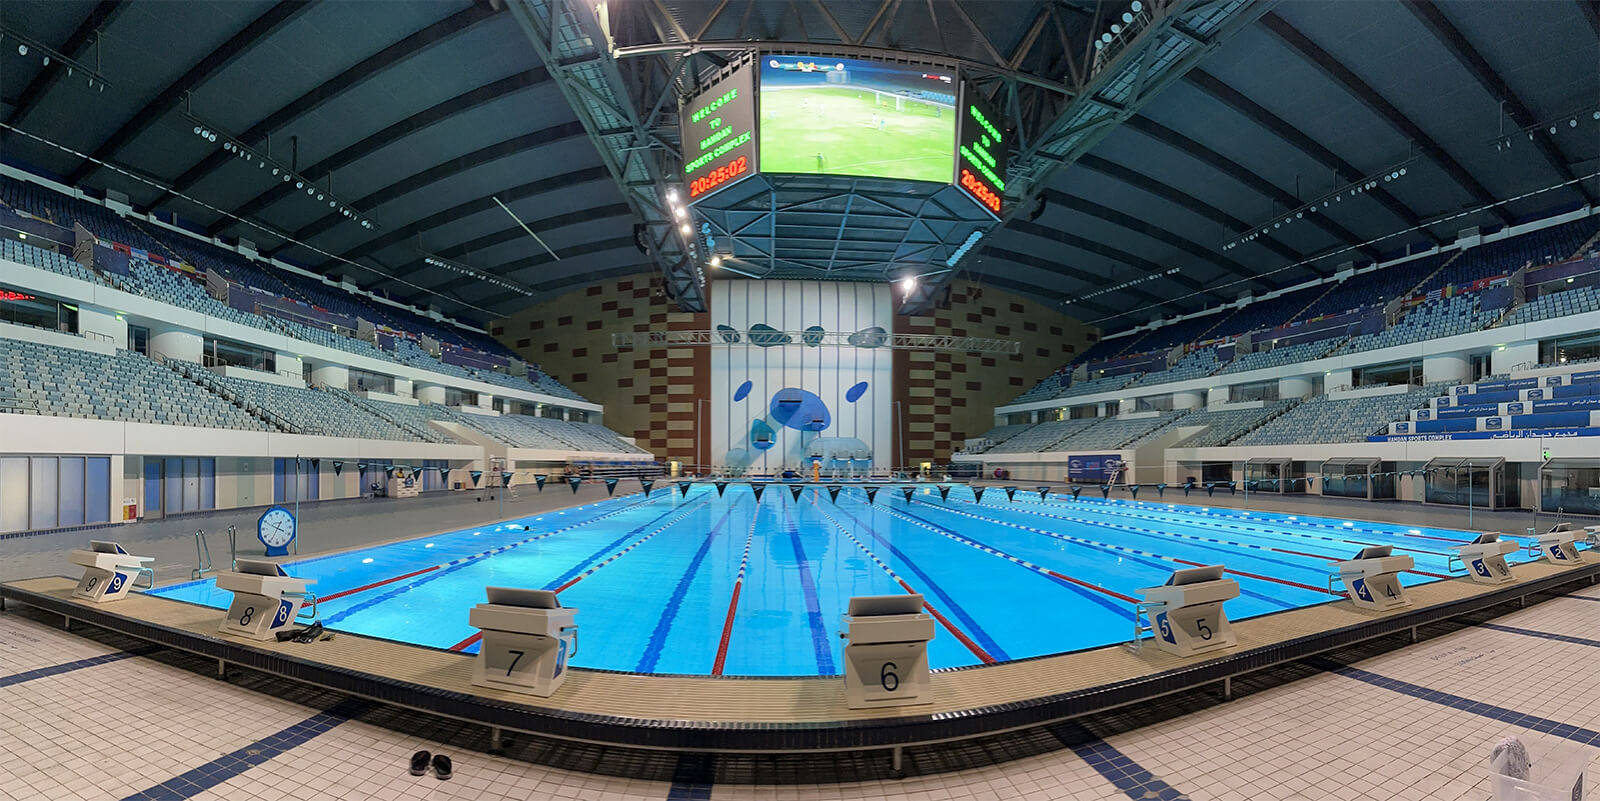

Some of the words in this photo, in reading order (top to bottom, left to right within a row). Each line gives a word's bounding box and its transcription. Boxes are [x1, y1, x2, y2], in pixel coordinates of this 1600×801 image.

[691, 88, 738, 123] WELCOME
[709, 117, 722, 129] TO
[970, 105, 1002, 142] WELCOME
[700, 125, 733, 150] HAMDAN
[685, 152, 714, 173] SPORTS
[713, 130, 752, 158] COMPLEX
[690, 156, 747, 197] 20:25:02
[1428, 433, 1453, 441] COMPLEX
[1554, 548, 1561, 558] 2
[1477, 562, 1485, 575] 3
[1496, 563, 1507, 577] 3
[86, 577, 98, 592] 9
[113, 577, 122, 590] 9
[1359, 584, 1367, 598] 4
[1385, 583, 1397, 600] 4
[240, 606, 255, 626] 8
[279, 605, 288, 622] 8
[1160, 619, 1170, 638] 5
[1196, 618, 1212, 640] 5
[506, 650, 524, 677] 7
[881, 661, 899, 692] 6
